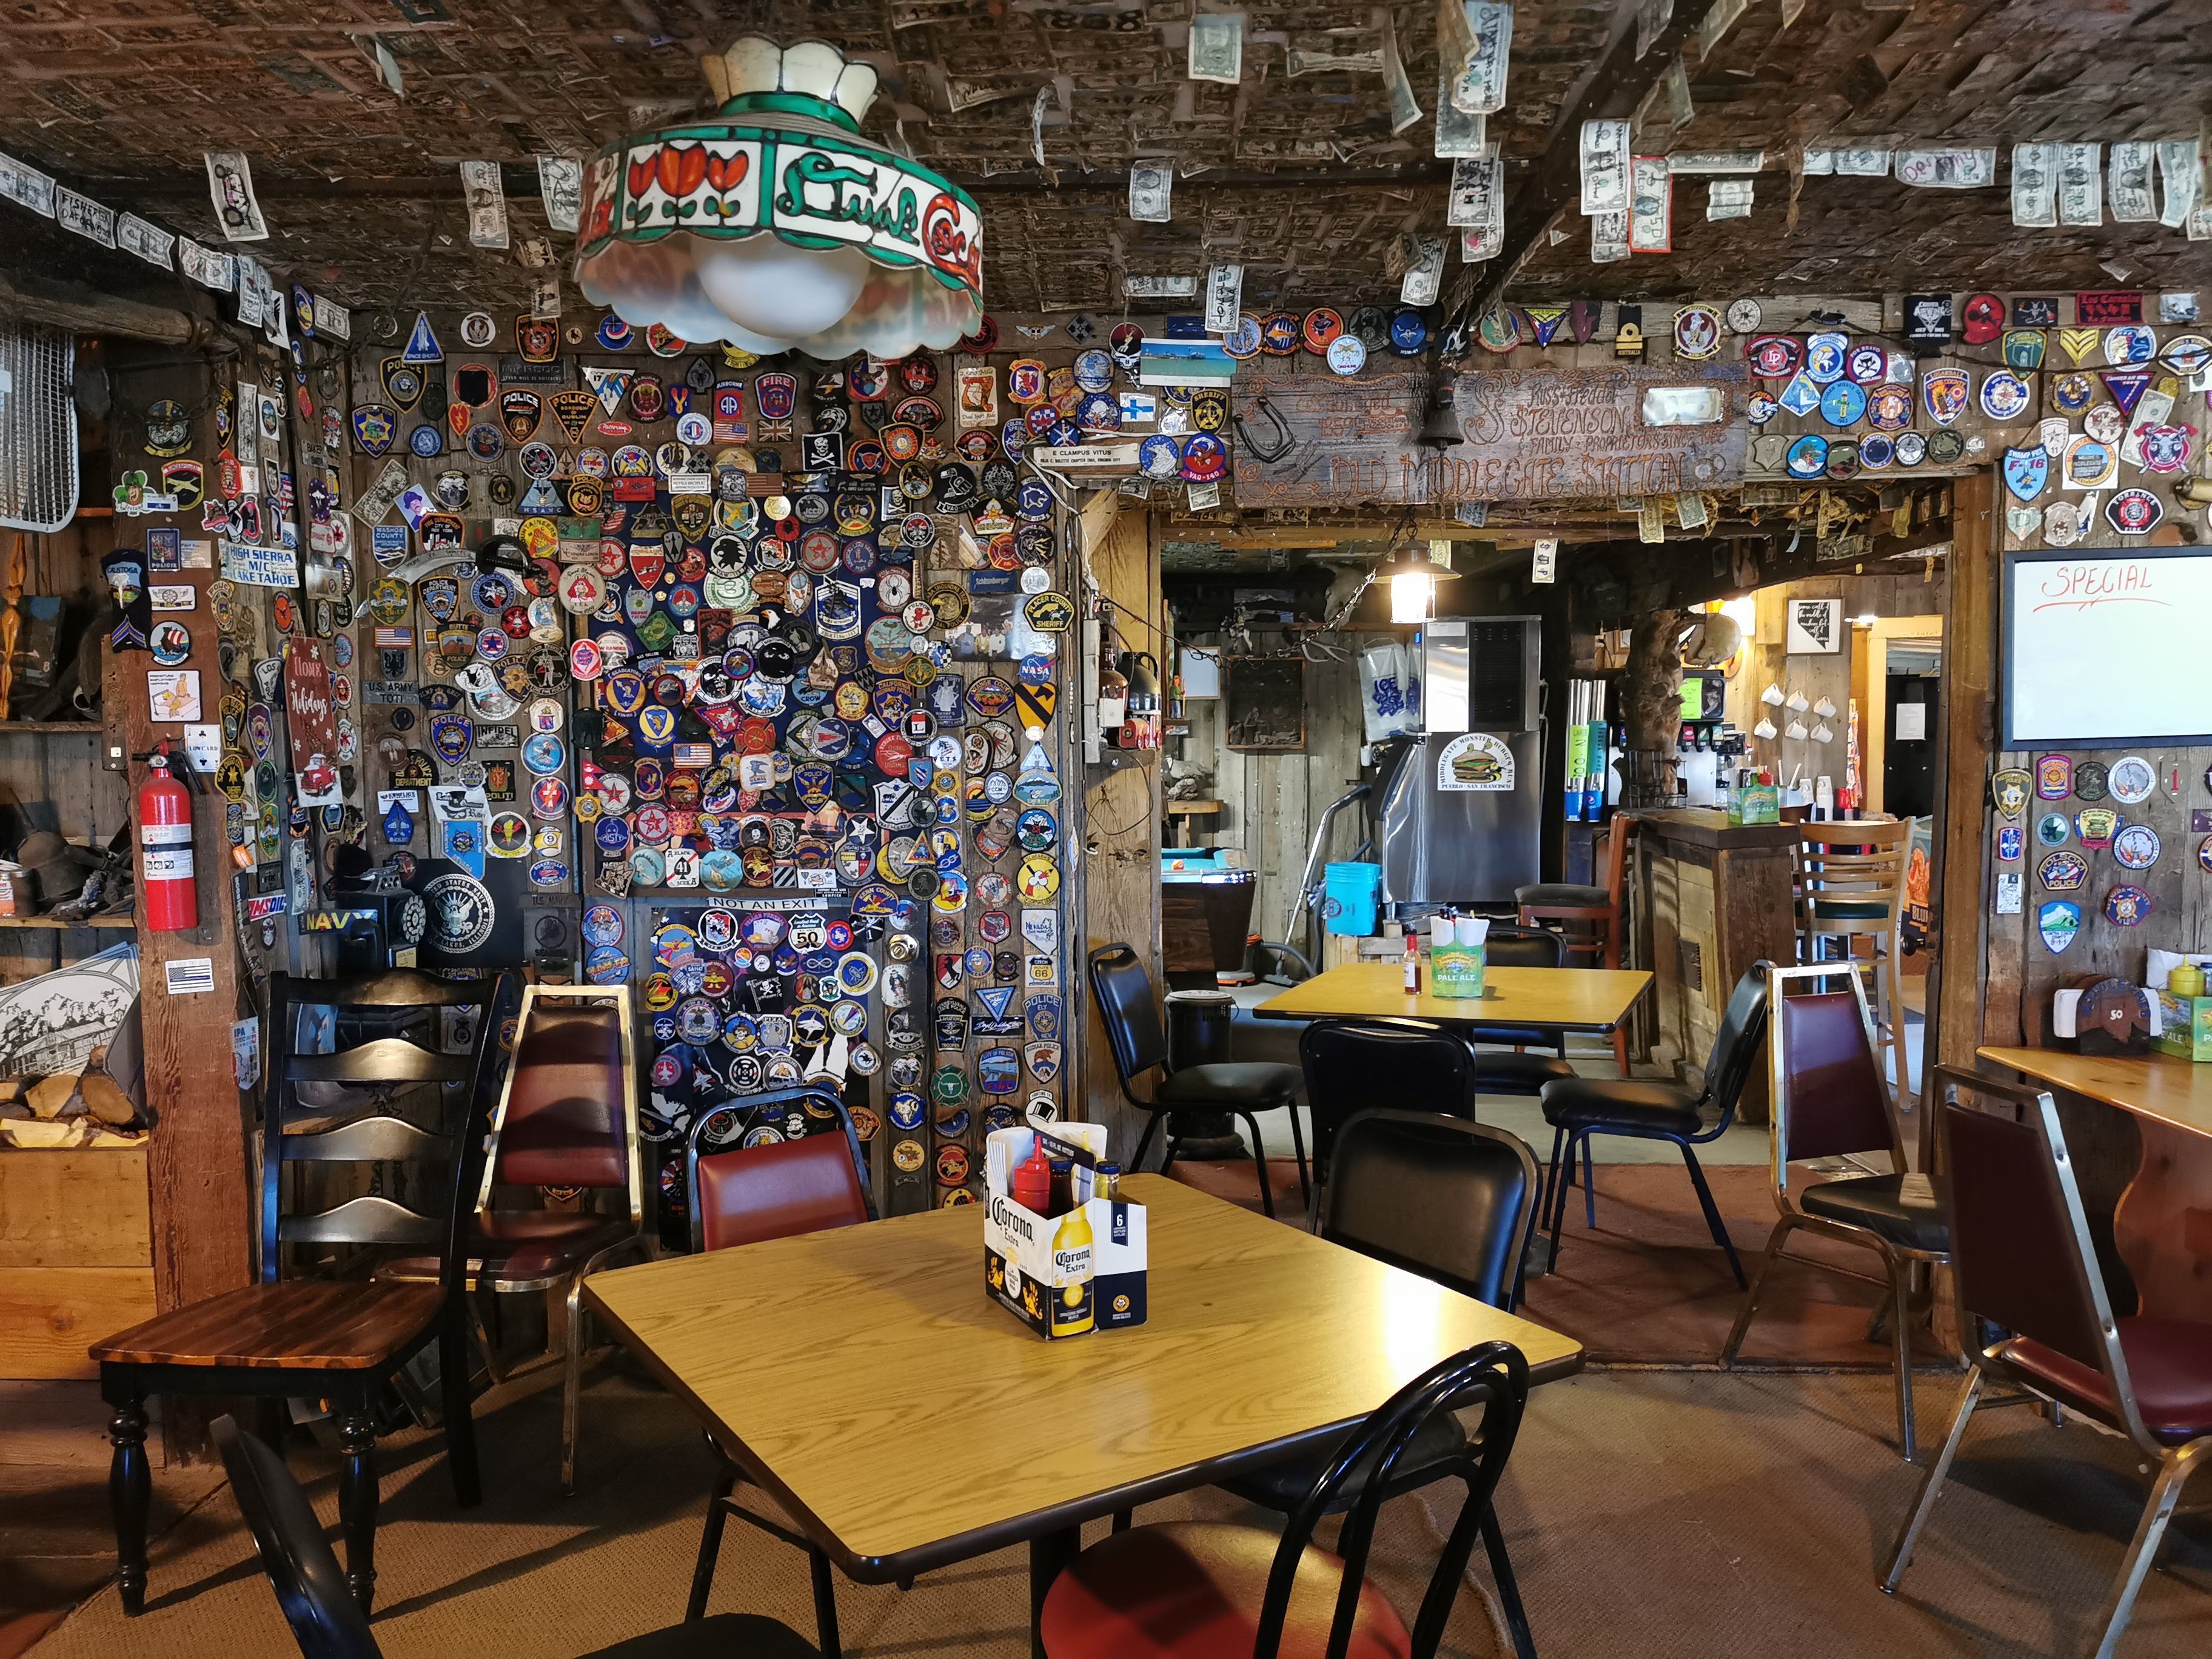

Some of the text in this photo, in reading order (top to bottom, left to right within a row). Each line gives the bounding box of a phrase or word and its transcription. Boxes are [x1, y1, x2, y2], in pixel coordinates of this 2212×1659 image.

[1850, 348, 1861, 358] FOX
[387, 362, 421, 374] POLICE
[763, 377, 791, 387] FIRE
[504, 393, 538, 407] POLICE
[552, 395, 597, 407] POLICE
[1194, 392, 1225, 401] SHERIFF
[1510, 405, 1630, 437] STEVENSON
[367, 444, 384, 454] POLICE
[1529, 437, 1572, 455] FAMILY
[1188, 470, 1219, 480] VAQ-140
[1332, 455, 1387, 498] OLD
[1400, 452, 1686, 503] MIDDLEGATE STATION
[2113, 490, 2157, 506] TORRANCE
[230, 548, 293, 563] HIGH SIERRA
[249, 561, 270, 573] M/C
[258, 572, 295, 585] TAHOE
[2042, 565, 2153, 597] SPECIAL
[423, 585, 457, 594] DEPARTMENT
[1029, 593, 1071, 613] PLACER COUNTY
[263, 663, 277, 675] LOS
[495, 658, 526, 669] POLICE
[612, 669, 642, 677] GLADIATORS
[1022, 665, 1050, 675] NASA
[369, 683, 413, 691] U.S. ARMY
[878, 682, 911, 690] CALIFORNIA
[291, 688, 328, 721] Holidays
[432, 716, 471, 728] POLICE
[477, 726, 514, 737] INFIDEL
[1439, 740, 1460, 785] MIDDLEGATE
[1459, 733, 1492, 744] MONSTER
[1492, 739, 1513, 767] BURGER
[415, 757, 432, 777] POLICE
[805, 763, 832, 773] FRANCISCO
[396, 778, 431, 786] DEPARTMENT
[675, 862, 689, 871] 41
[2041, 851, 2085, 874] FOLSOM
[2048, 879, 2077, 888] POLICE
[445, 879, 487, 909] STATES NAVY
[859, 887, 896, 901] KERN COUNTY
[2129, 888, 2151, 906] COUNTY
[714, 898, 817, 909] NOT AN EXIT
[469, 914, 489, 945] ILLINOIS
[797, 932, 817, 943] 50
[1026, 996, 1060, 1011] POLICE
[2110, 1009, 2123, 1020] 50
[235, 1027, 246, 1037] IPA
[2167, 1031, 2184, 1044] ALE
[987, 1082, 1013, 1090] FIRE
[992, 1196, 1034, 1241] Corona
[1116, 1214, 1123, 1227] 6
[1004, 1228, 1019, 1247] Extra
[1055, 1248, 1090, 1267] Corona
[1065, 1263, 1085, 1273] Extra
